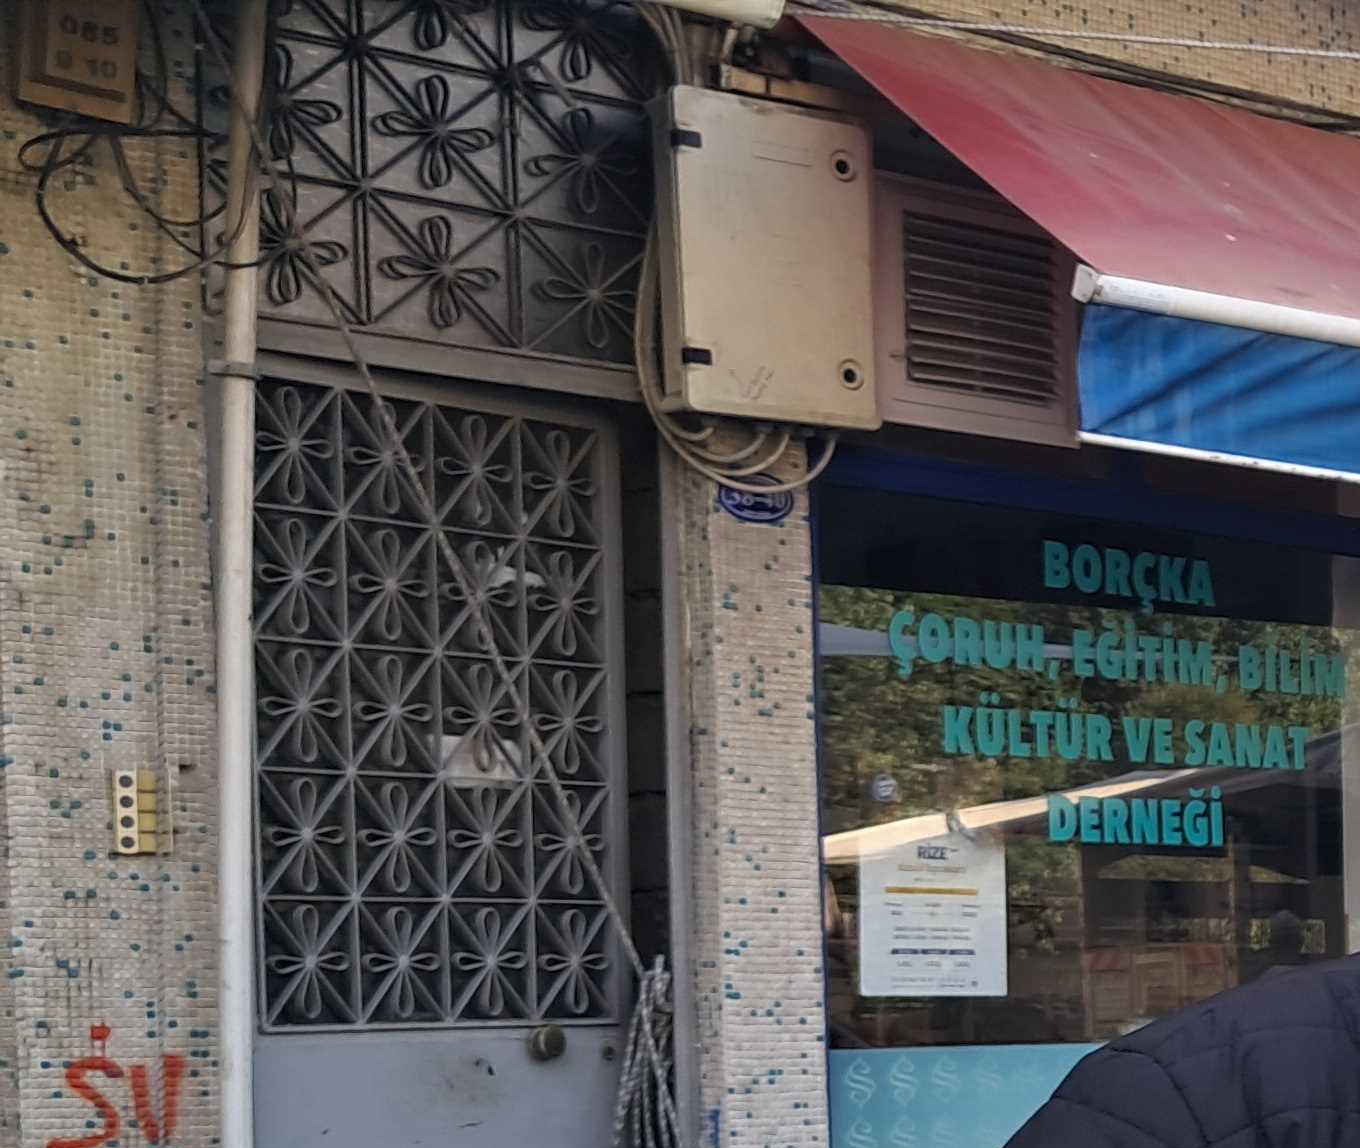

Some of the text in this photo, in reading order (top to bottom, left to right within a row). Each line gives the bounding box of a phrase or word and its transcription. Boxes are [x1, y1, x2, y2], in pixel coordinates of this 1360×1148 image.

[1044, 540, 1216, 616] BORÇKA
[888, 609, 1345, 697] ÇORUH, EĞİTİM, BİLİM
[943, 691, 1310, 770] KÜLTÜR VE SANAT
[1047, 786, 1224, 848] DERNEĞİ
